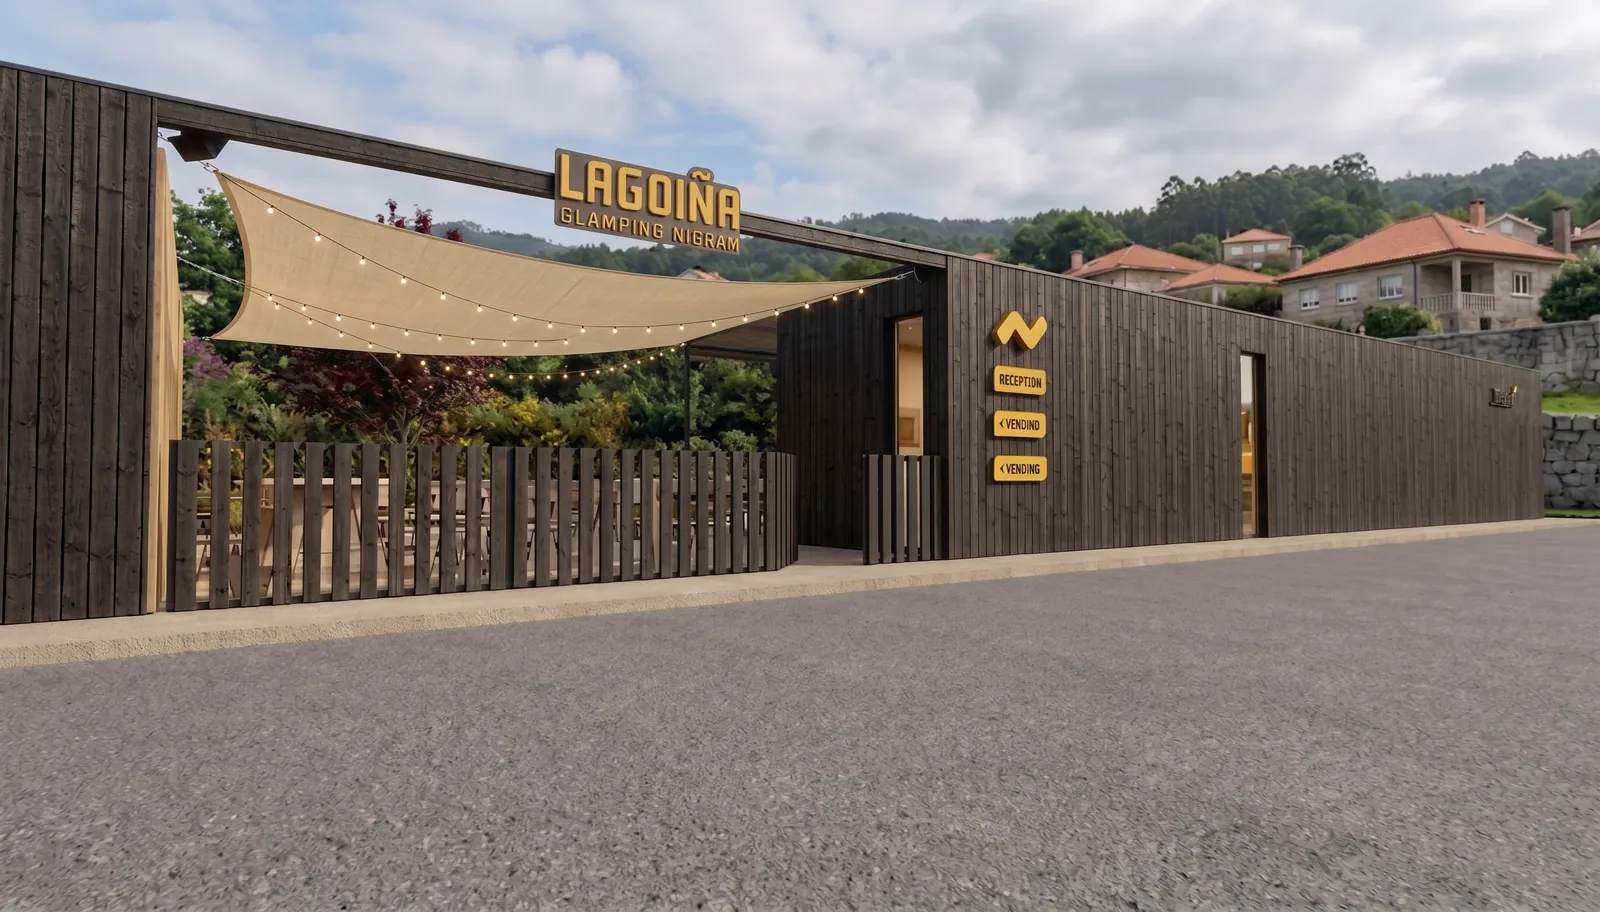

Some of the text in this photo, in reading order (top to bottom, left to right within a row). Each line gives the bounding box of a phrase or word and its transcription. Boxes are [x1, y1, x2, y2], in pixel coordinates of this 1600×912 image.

[559, 153, 740, 230] LAGOIÑA
[560, 207, 740, 252] GLAMPING NIGRAM
[1005, 463, 1040, 475] VENDING
